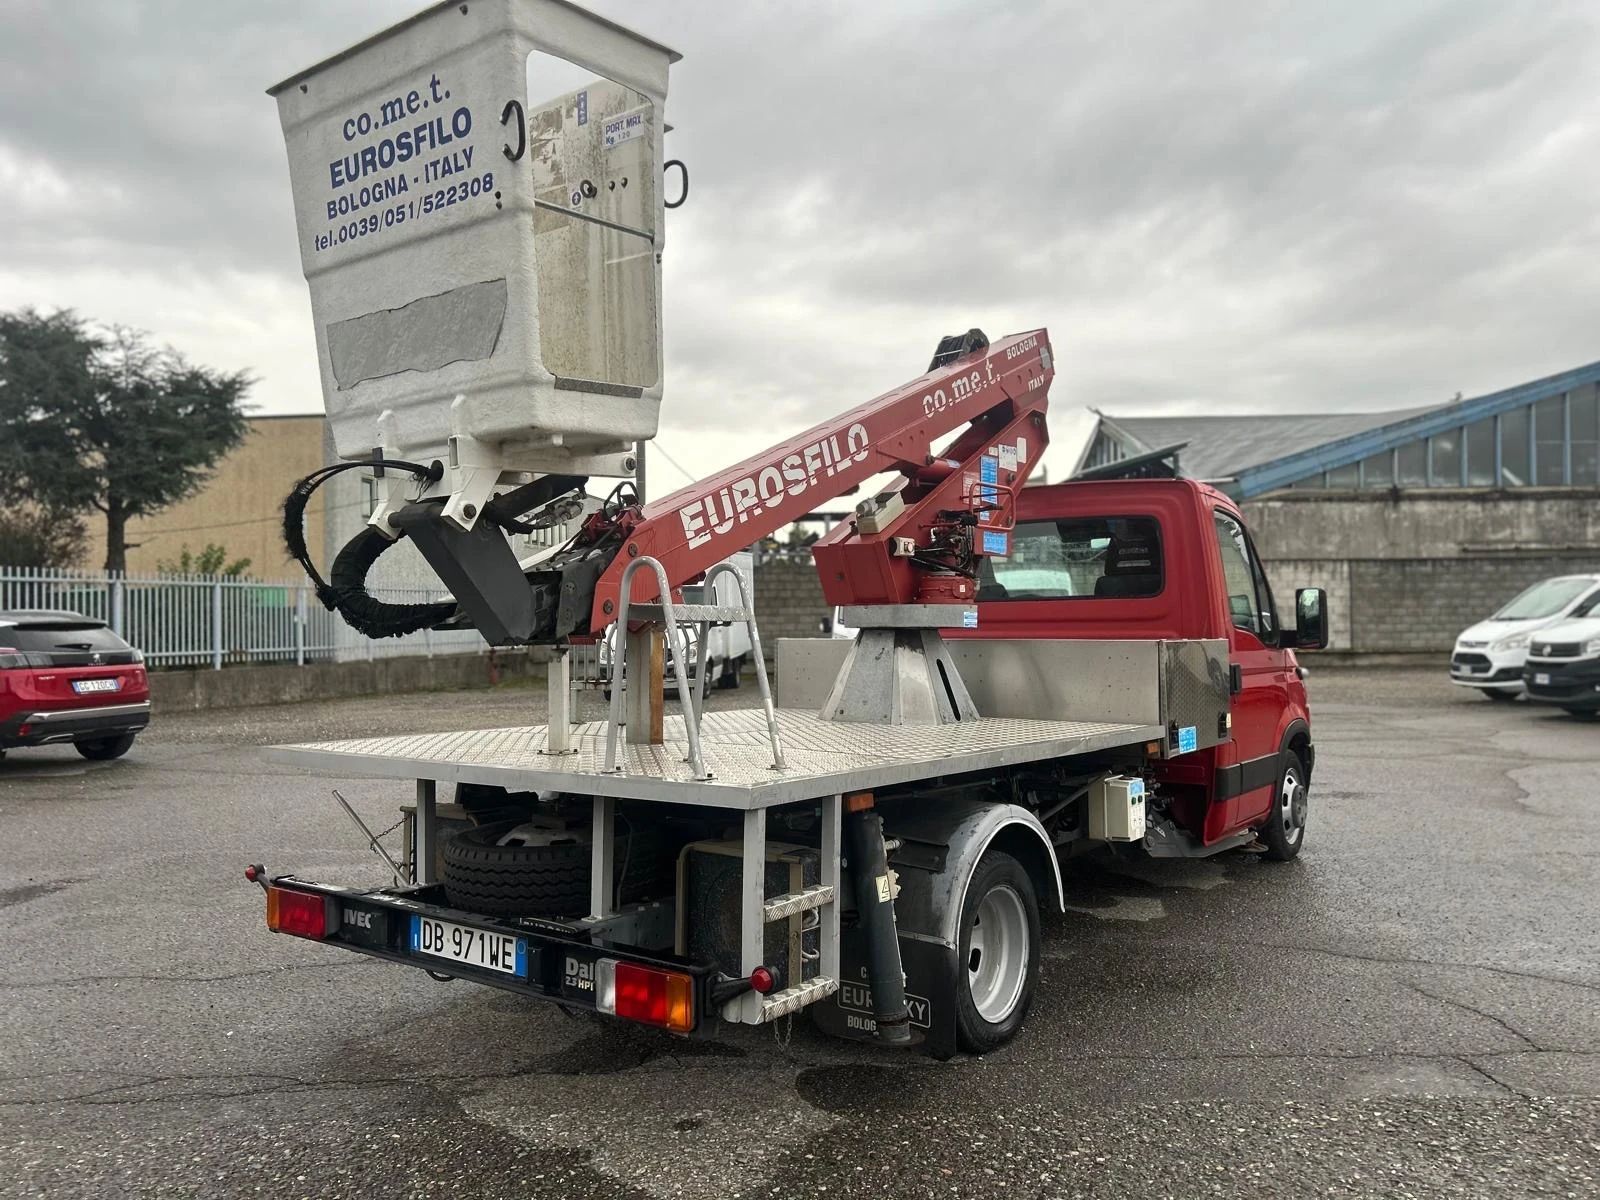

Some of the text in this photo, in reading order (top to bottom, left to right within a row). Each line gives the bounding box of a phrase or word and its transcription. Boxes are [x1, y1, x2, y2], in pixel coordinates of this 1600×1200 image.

[343, 74, 450, 141] co.me.t.
[626, 115, 641, 128] MAX
[329, 107, 472, 189] EUROSFILO
[327, 174, 408, 220] BOLOGNA
[424, 146, 473, 183] ITALY
[315, 172, 493, 251] tel.0039/051/522308
[1006, 336, 1038, 360] BOLOGNA
[923, 359, 1001, 418] co.me.t.
[1028, 375, 1044, 392] ITALY
[679, 423, 869, 551] EUROSFILO
[344, 908, 372, 929] IVEC
[423, 920, 444, 953] DB
[452, 928, 514, 970] 971WE
[565, 957, 594, 980] Dai
